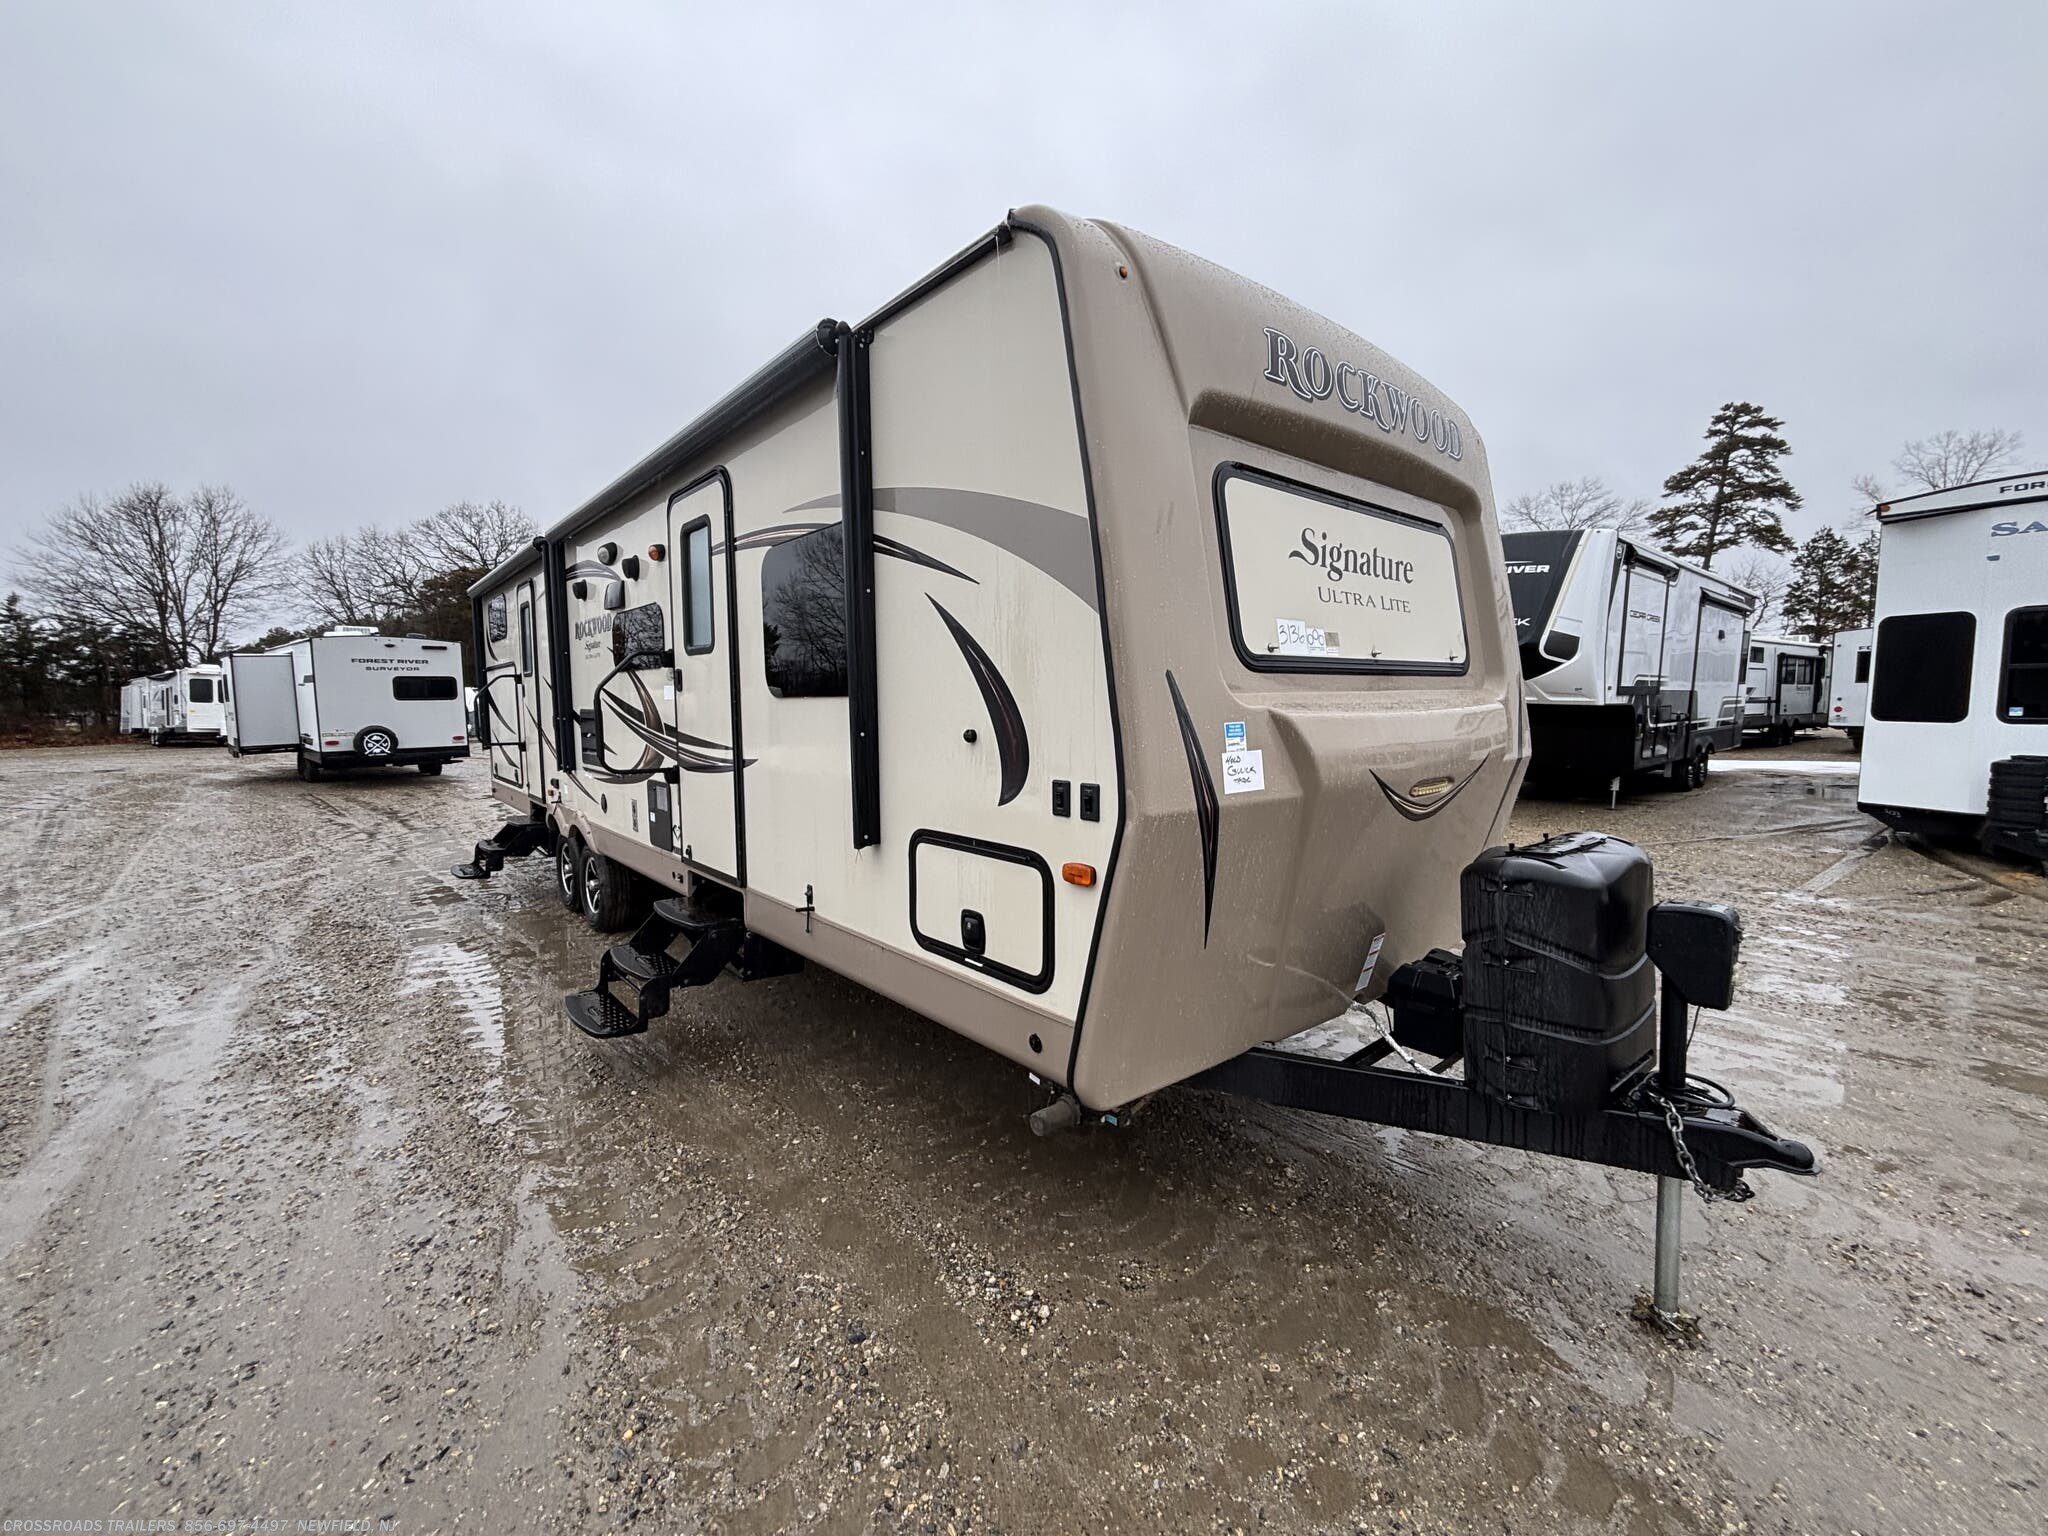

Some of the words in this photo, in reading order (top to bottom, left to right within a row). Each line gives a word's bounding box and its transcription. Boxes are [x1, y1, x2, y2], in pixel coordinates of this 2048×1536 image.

[1263, 327, 1464, 461] ROCKWOOD
[1999, 481, 2048, 493] FOR
[1288, 527, 1414, 584] Signature
[1505, 564, 1550, 574] IVER
[1317, 586, 1377, 608] ULTRA
[1380, 594, 1412, 613] LITE
[575, 613, 612, 640] ROCKWOOD
